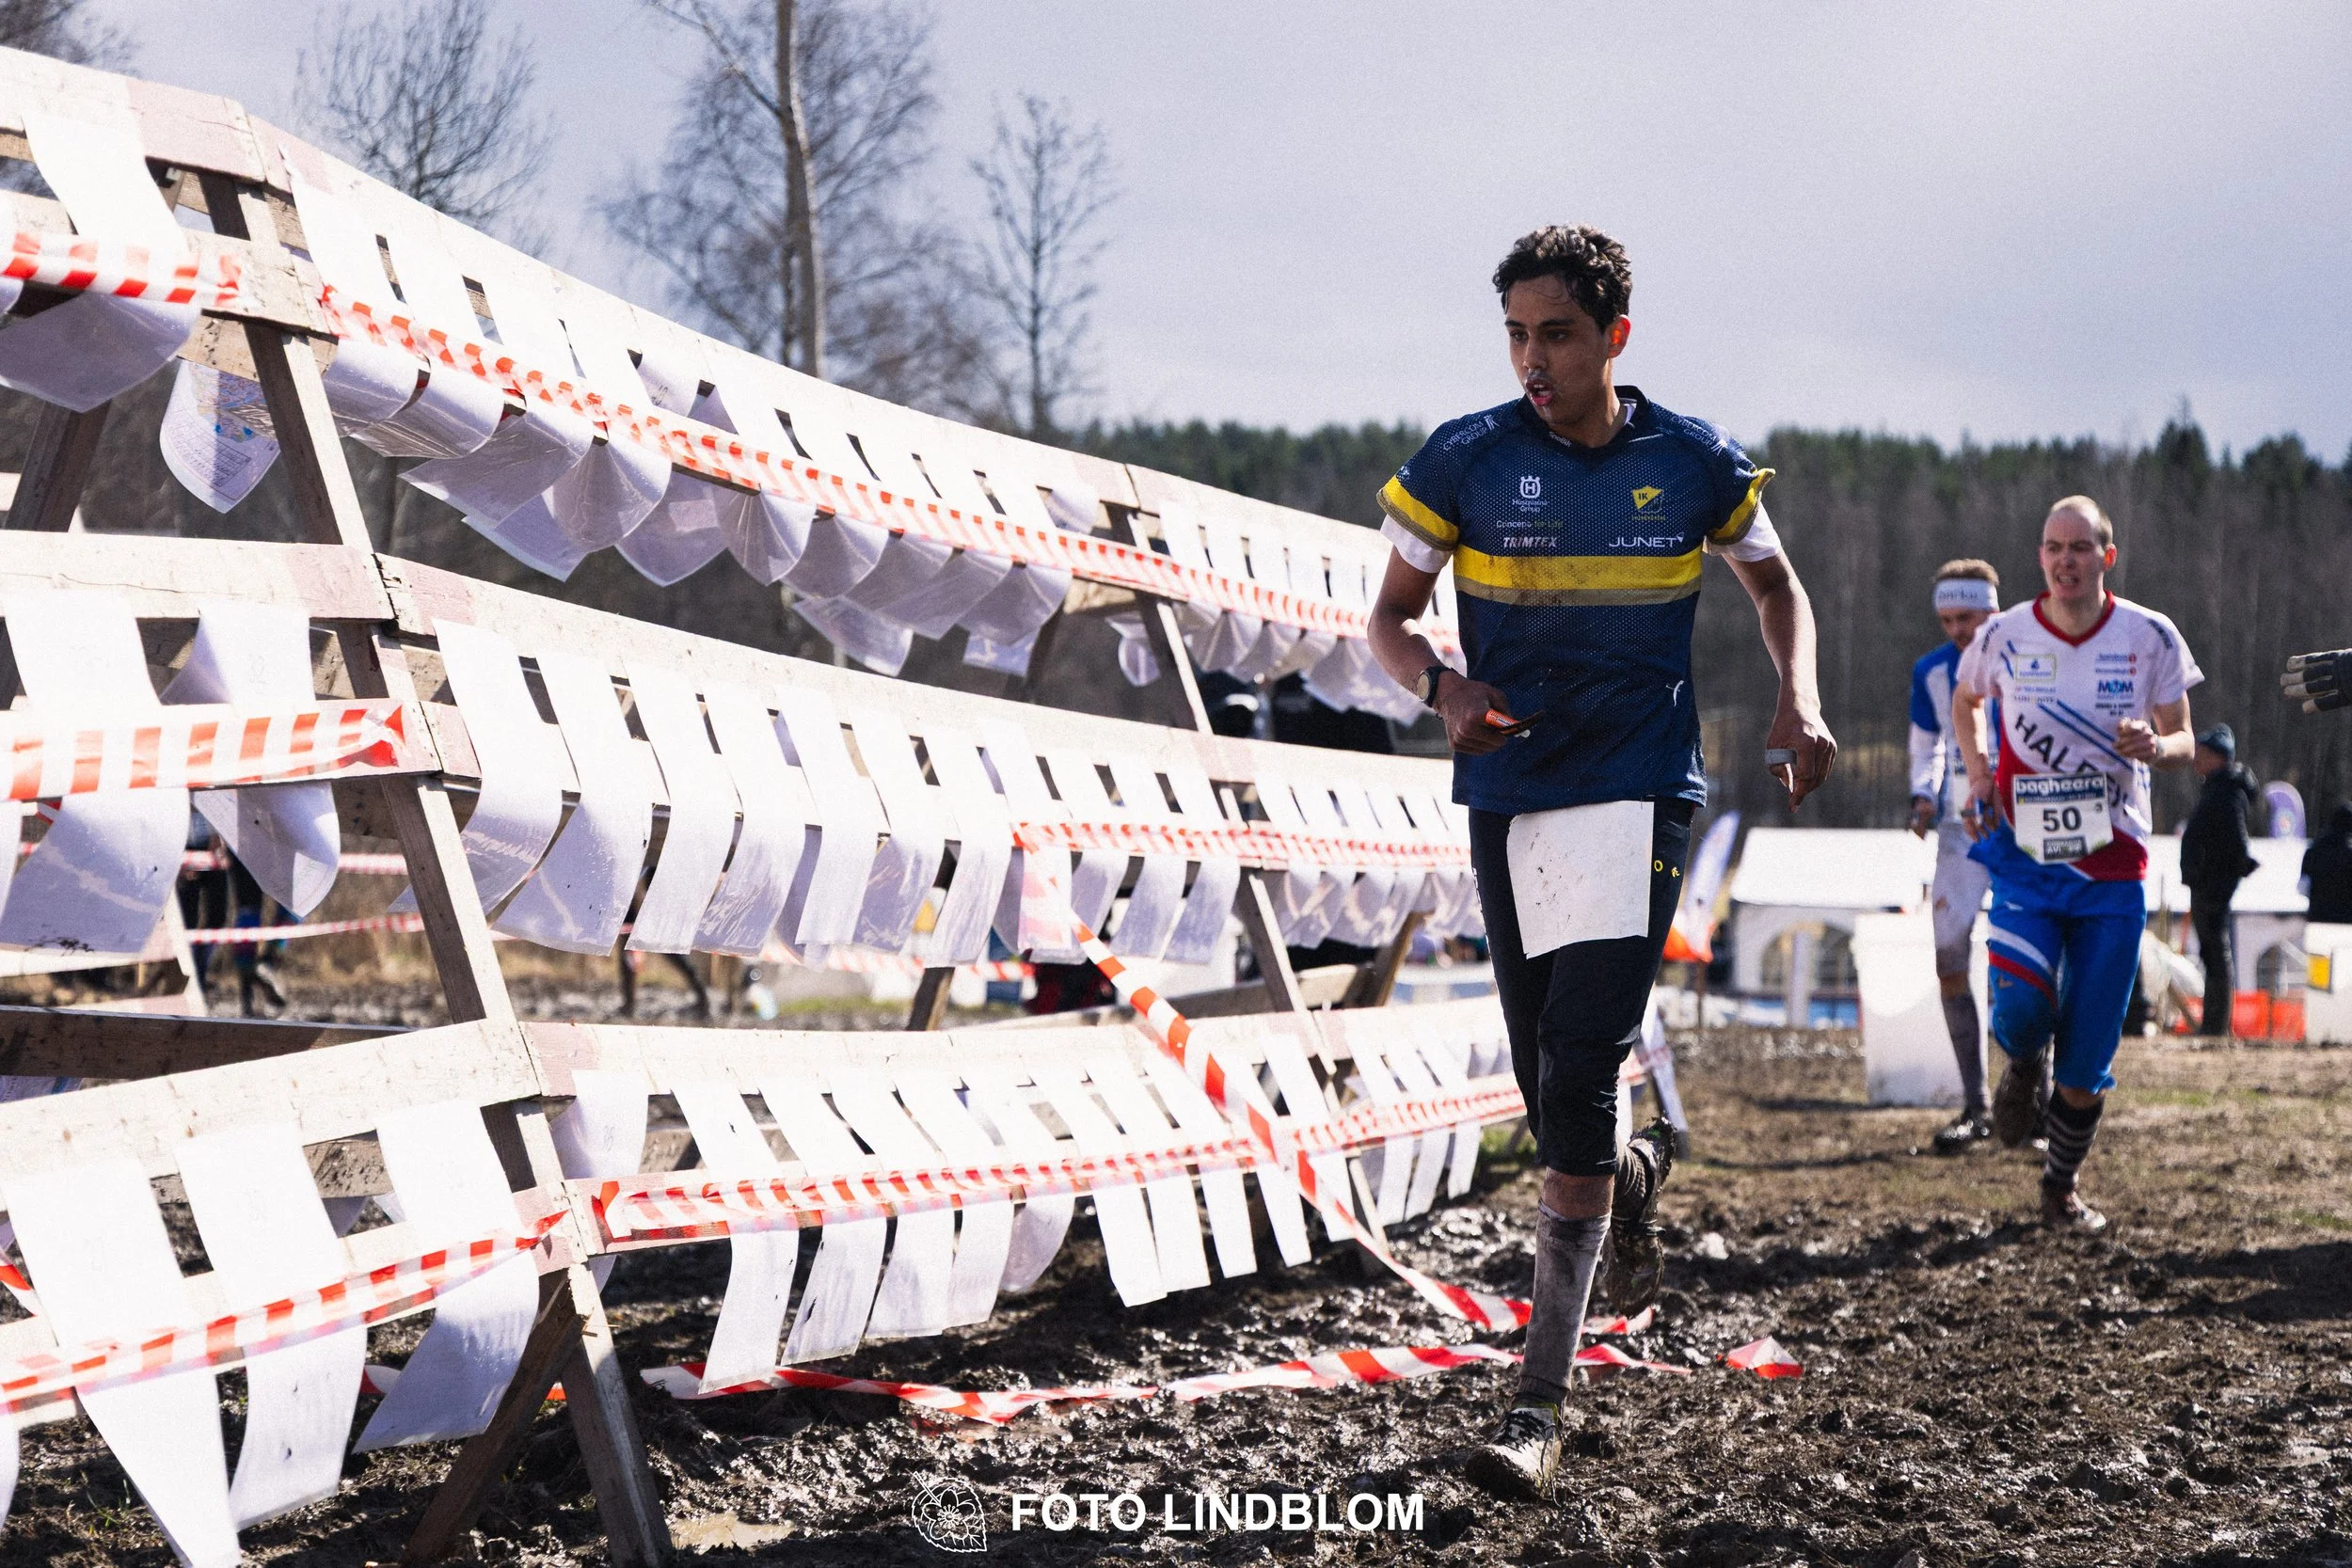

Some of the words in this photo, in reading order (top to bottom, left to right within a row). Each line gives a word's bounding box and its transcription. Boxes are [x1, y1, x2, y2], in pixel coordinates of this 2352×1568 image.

[1443, 420, 1484, 451] CYBERCOM
[1461, 427, 1487, 445] GROUP
[1672, 415, 1717, 442] CYBERCOM
[1684, 428, 1713, 446] GROUP
[1638, 492, 1648, 500] IK
[1503, 536, 1557, 547] TRIMTEX
[1609, 536, 1677, 547] JUNET
[2016, 777, 2104, 797] bagheera
[2042, 806, 2082, 832] 50
